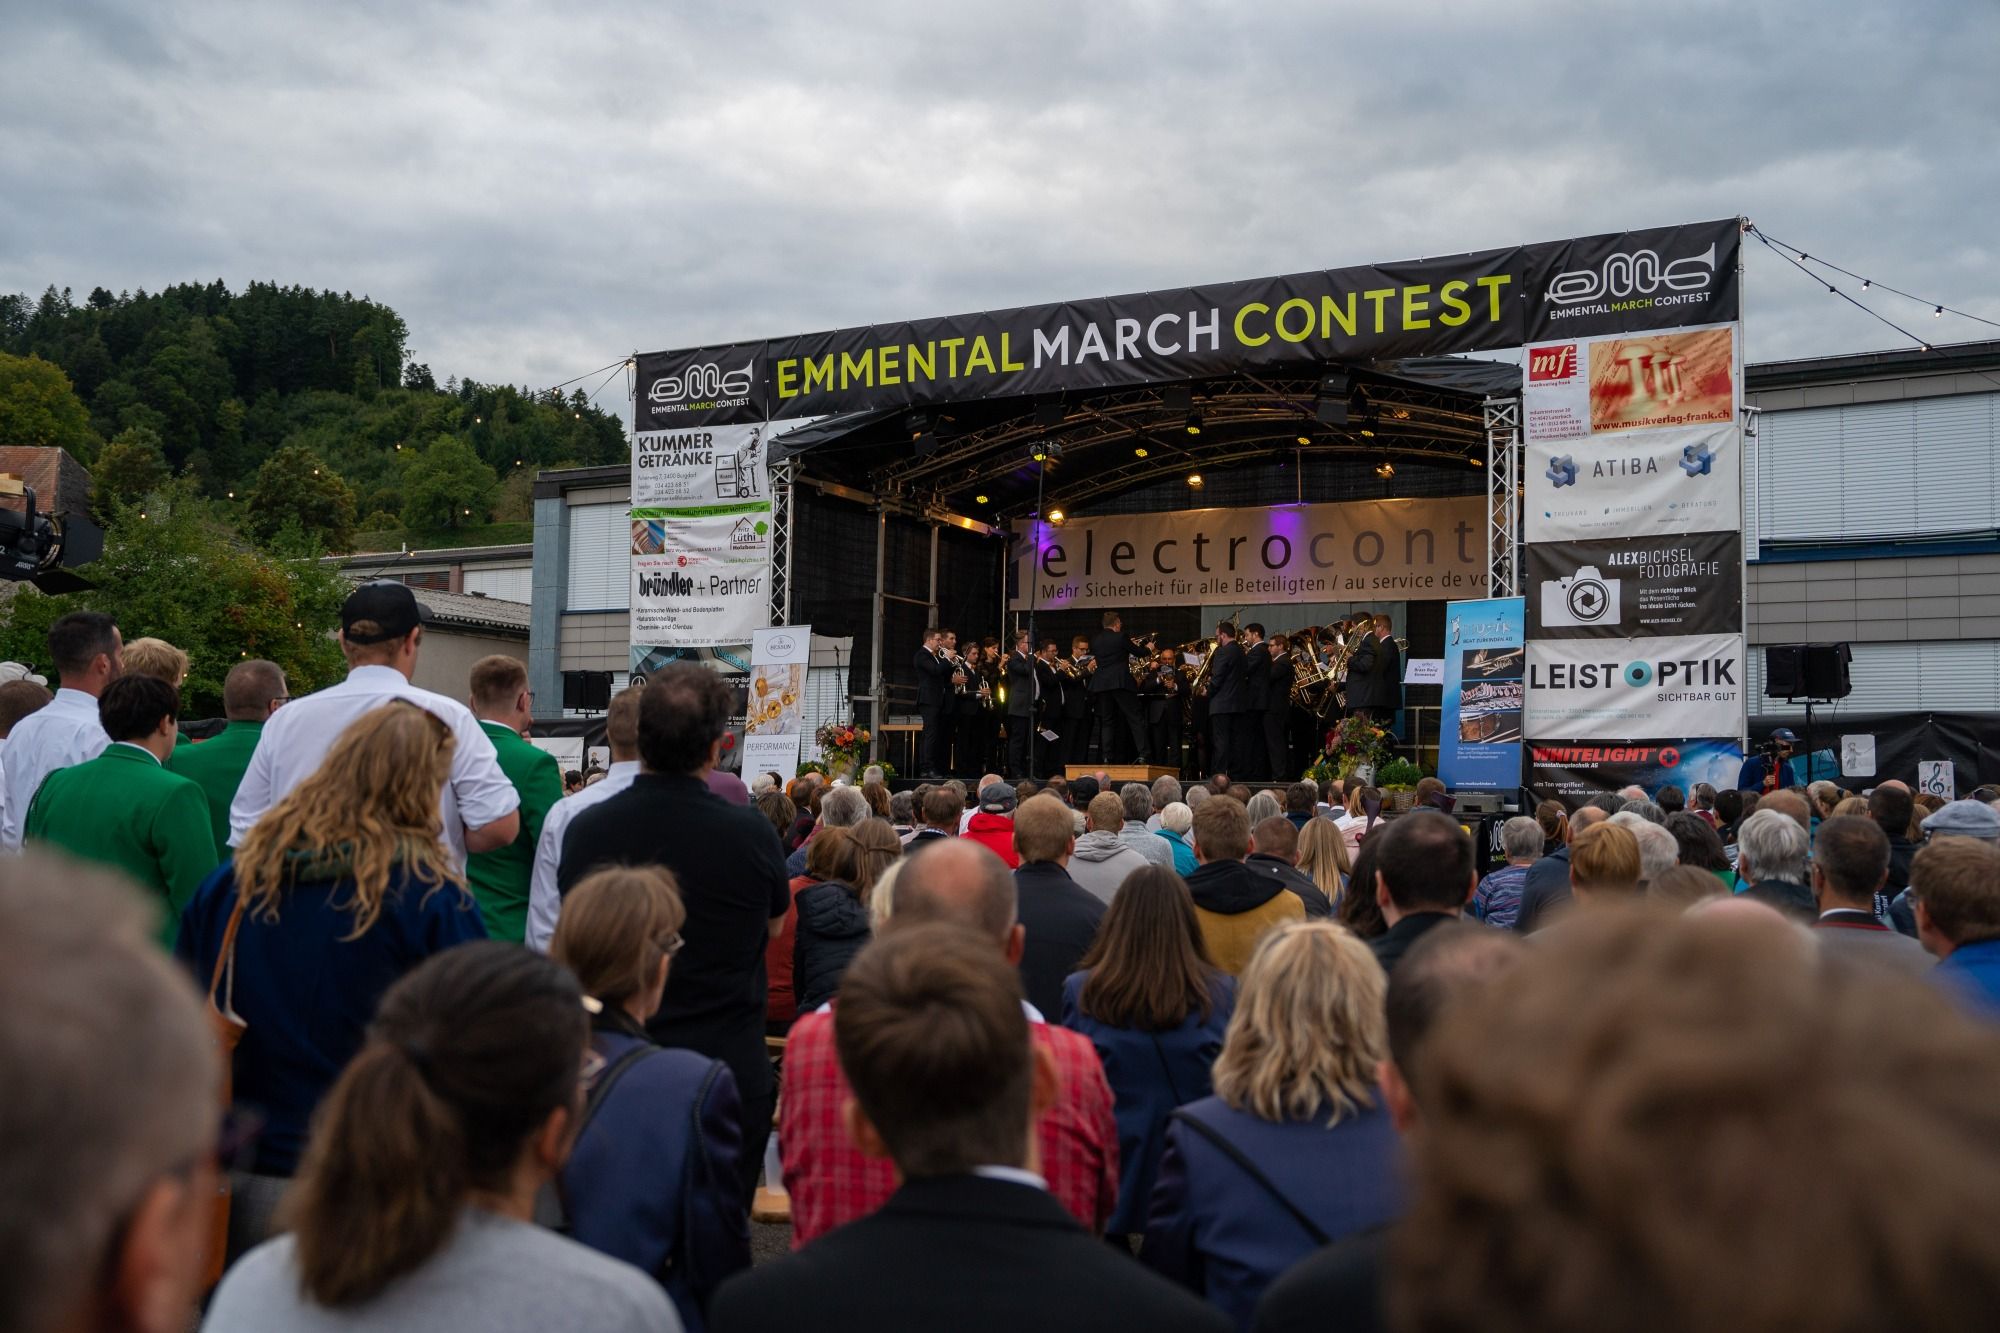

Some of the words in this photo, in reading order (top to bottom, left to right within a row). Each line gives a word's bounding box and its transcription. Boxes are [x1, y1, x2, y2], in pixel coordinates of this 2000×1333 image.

[1550, 304, 1610, 320] EMMENTAL
[1611, 298, 1653, 313] MARCH
[1654, 291, 1712, 306] CONTEST
[777, 332, 1025, 398] EMMENTAL
[1033, 307, 1219, 369] MARCH
[1234, 274, 1512, 347] CONTEST
[1532, 345, 1574, 378] mf
[716, 397, 750, 409] CONTEST
[1593, 410, 1730, 431] www.musikverlag-frank.ch
[638, 432, 713, 453] KUMMER
[638, 449, 713, 468] GETRÄNKE
[1593, 456, 1659, 478] ATIBA
[733, 532, 756, 542] Lüthi
[1640, 561, 1720, 579] FOTOGRAFIE
[639, 572, 694, 597] bründler
[710, 575, 762, 597] Partner
[1042, 583, 1079, 600] Mehr
[1086, 580, 1164, 598] Sicherheit
[1170, 579, 1193, 596] für
[1200, 577, 1228, 595] alle
[1236, 575, 1325, 596] Beteiligten
[1345, 576, 1365, 590] au
[1373, 572, 1433, 589] service
[1441, 570, 1462, 588] de
[1657, 692, 1711, 702] SICHTBAR
[1714, 692, 1737, 701] GUT
[746, 741, 797, 751] PERFORMANCE
[1532, 747, 1650, 762] WHITELIGHT
